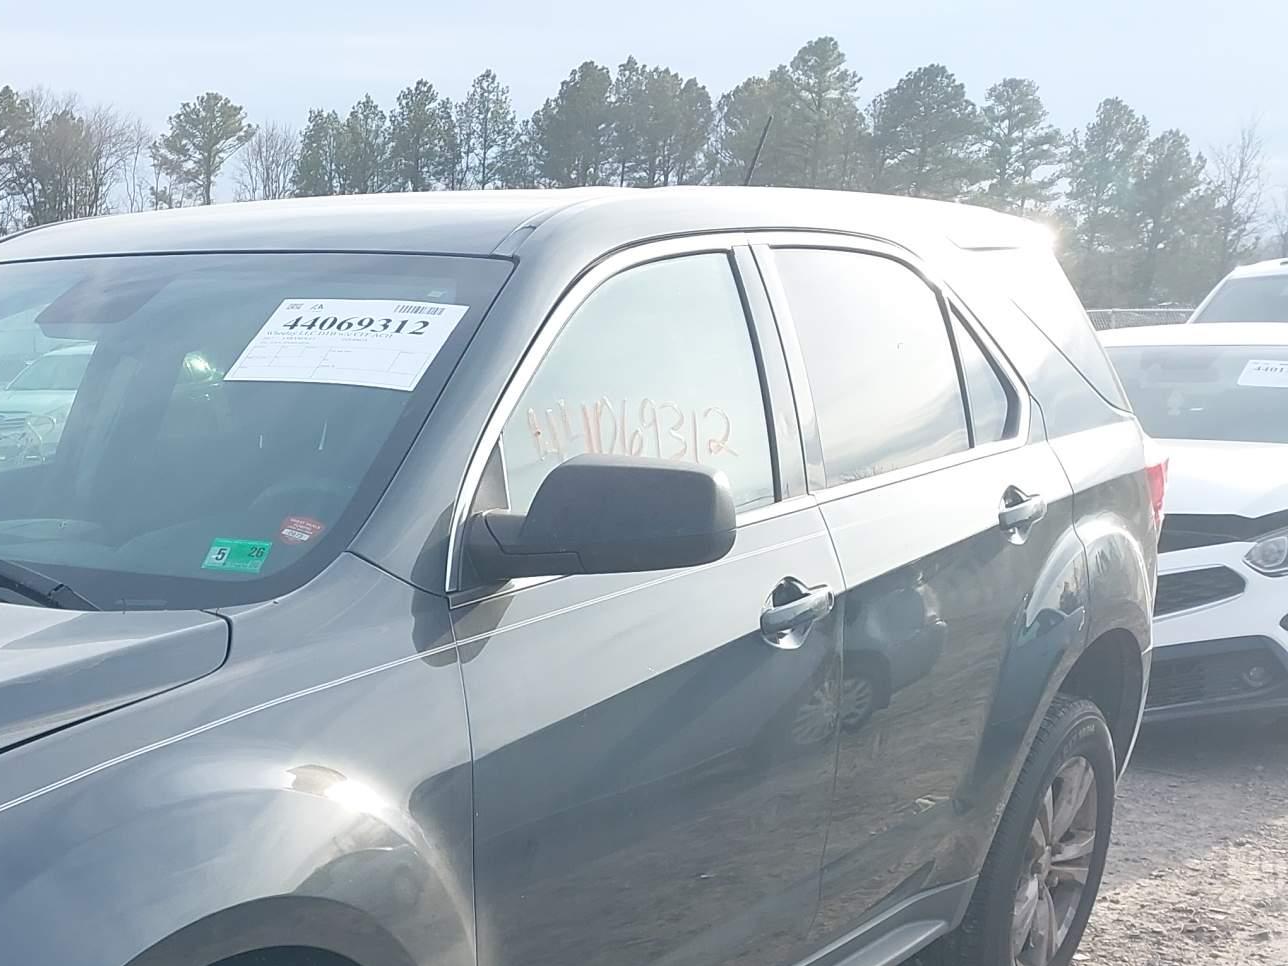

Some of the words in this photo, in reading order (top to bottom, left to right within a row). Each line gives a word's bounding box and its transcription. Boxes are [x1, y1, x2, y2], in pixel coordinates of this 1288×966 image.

[282, 315, 430, 336] 44069312
[215, 548, 227, 561] 5
[250, 546, 265, 558] 26
